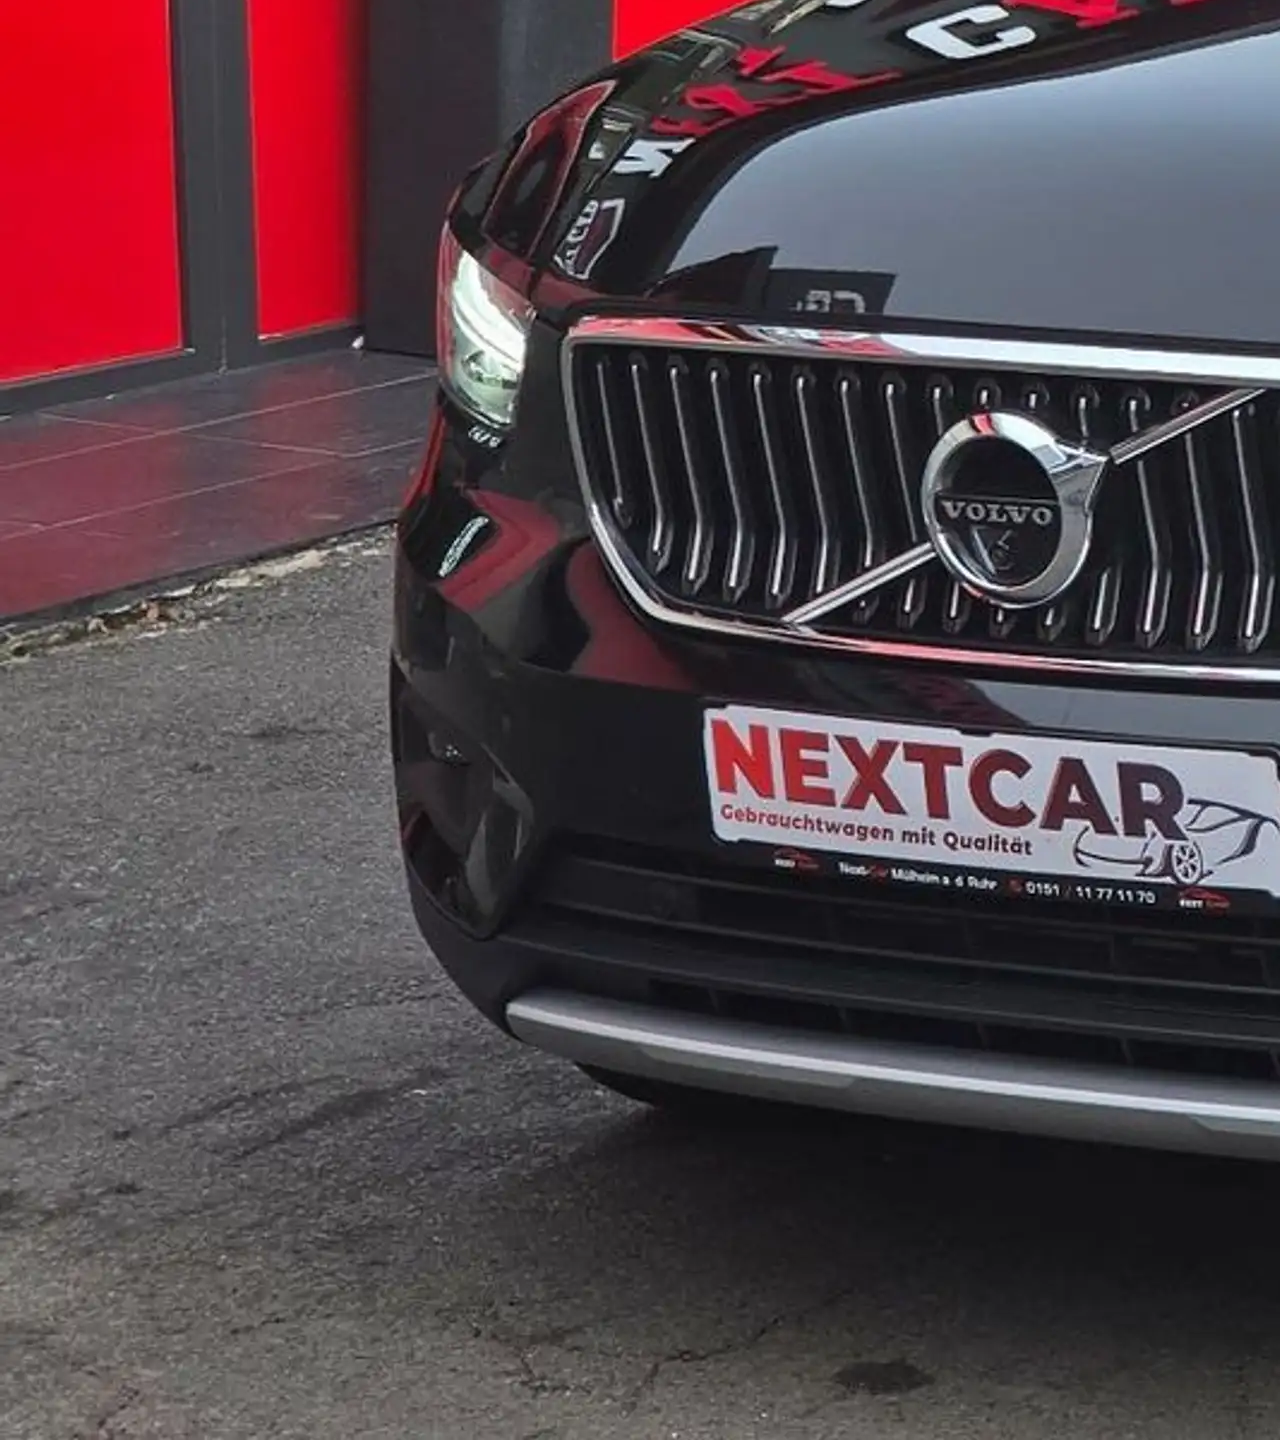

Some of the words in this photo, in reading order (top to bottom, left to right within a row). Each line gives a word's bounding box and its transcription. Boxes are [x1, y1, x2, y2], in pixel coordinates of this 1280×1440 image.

[940, 500, 1055, 526] VOLVO
[710, 719, 1190, 842] NEXTCAR
[720, 803, 894, 842] Gebrauchtwagen
[901, 826, 936, 846] mit
[942, 830, 1033, 857] Qualität
[1025, 881, 1060, 897] 0151
